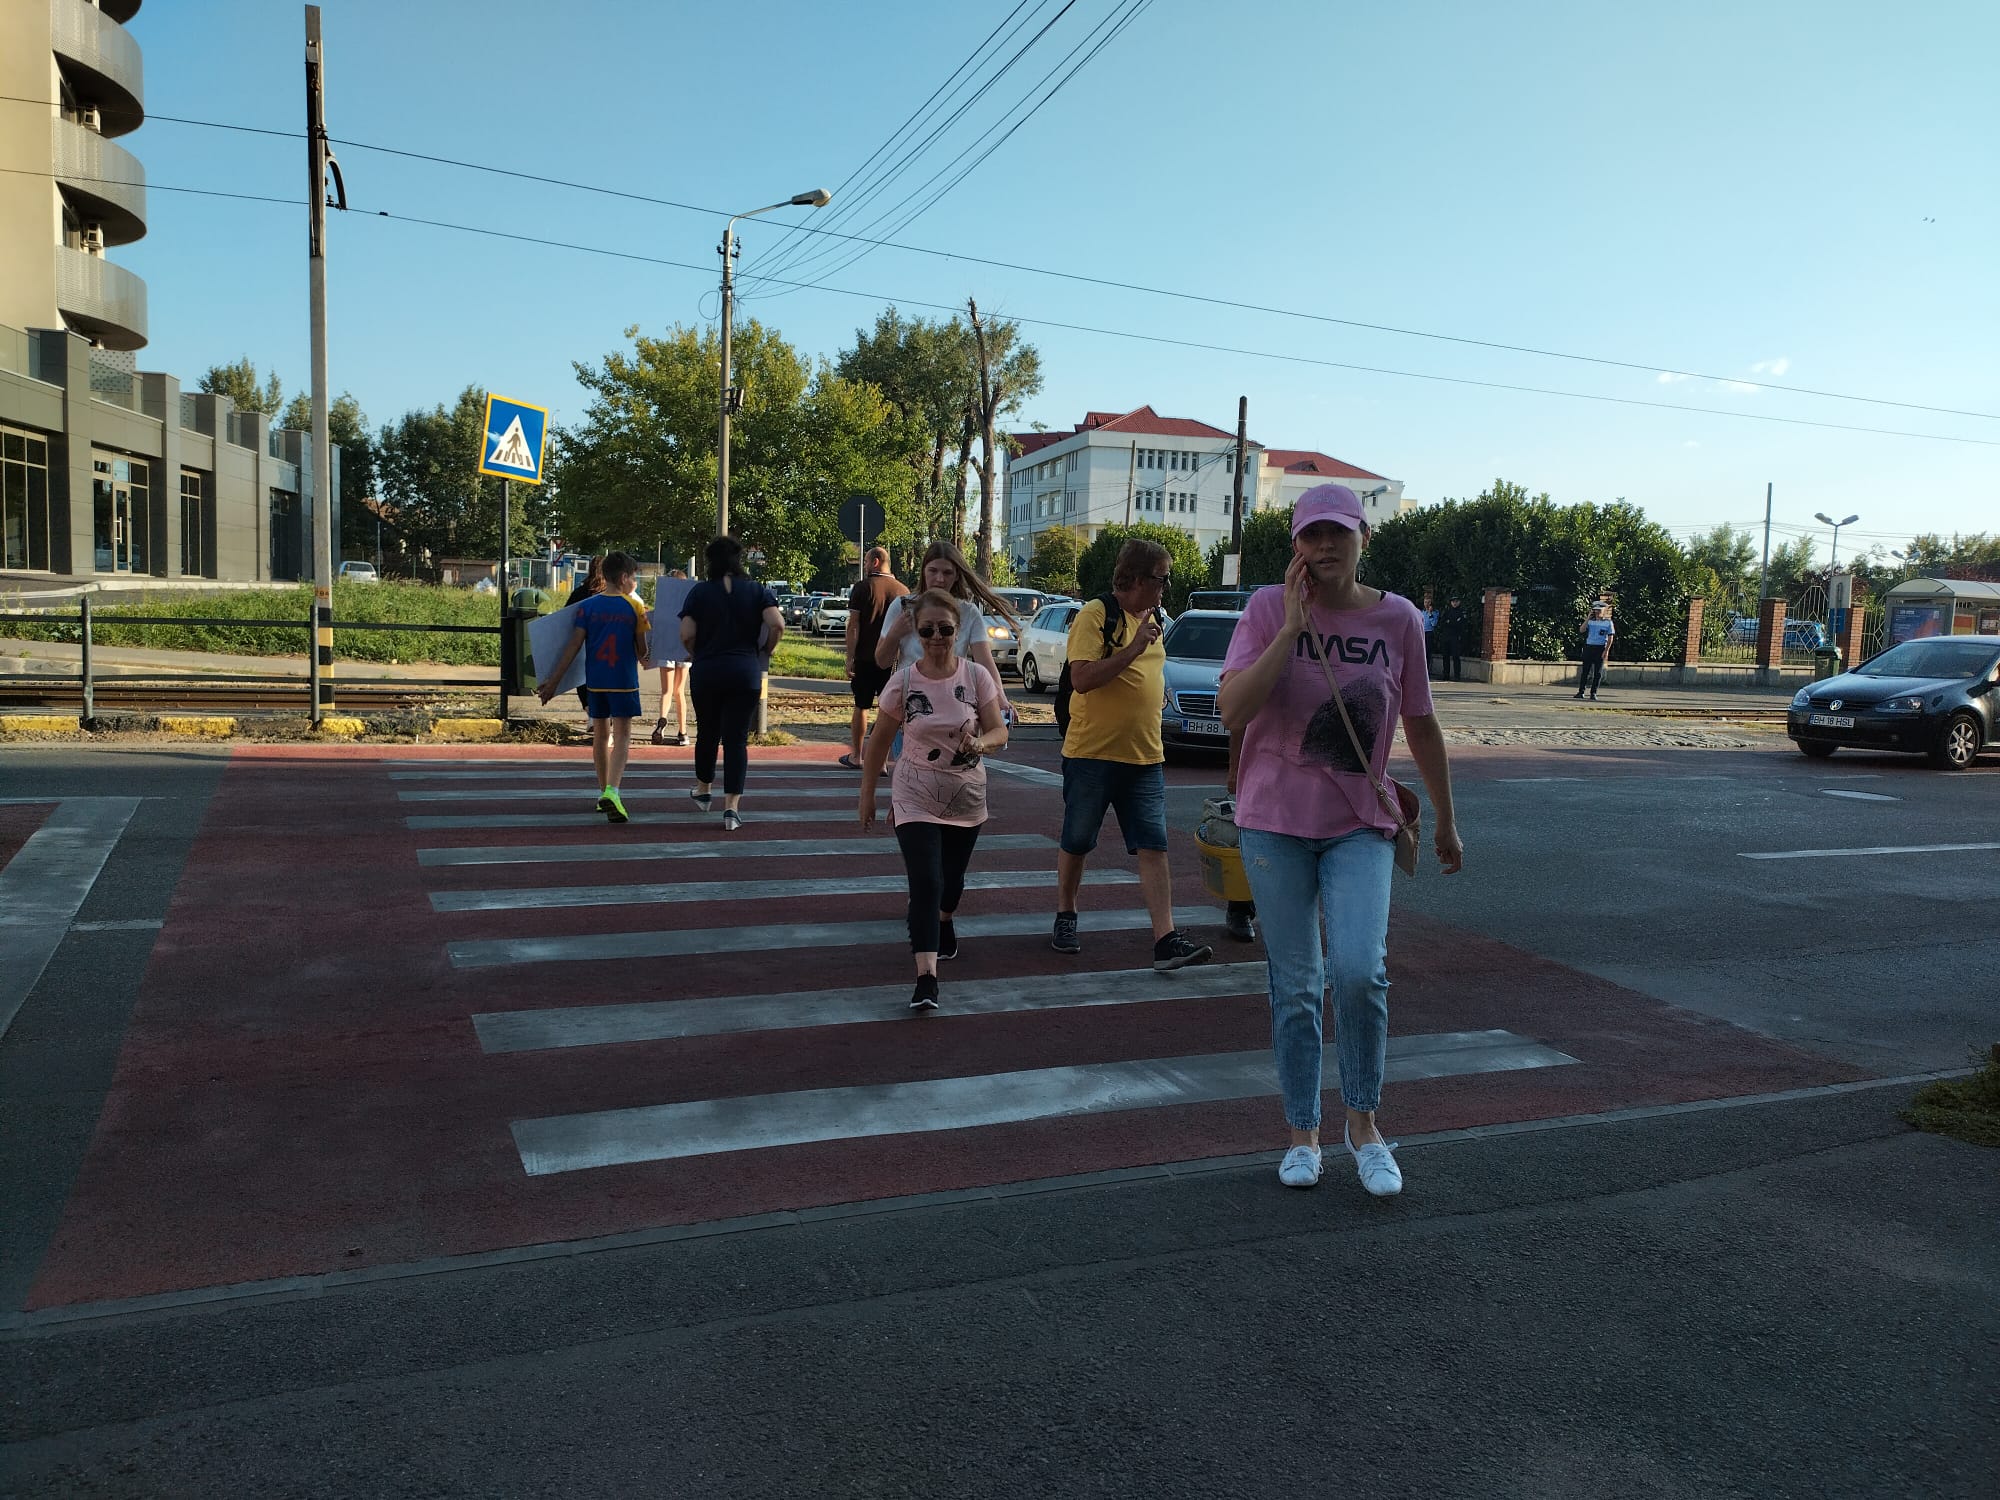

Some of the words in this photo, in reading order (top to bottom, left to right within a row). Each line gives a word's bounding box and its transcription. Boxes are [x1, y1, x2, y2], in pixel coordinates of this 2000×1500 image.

[595, 633, 620, 668] 4
[1297, 631, 1389, 667] NASA
[1189, 721, 1203, 732] BH
[1206, 723, 1219, 733] 88
